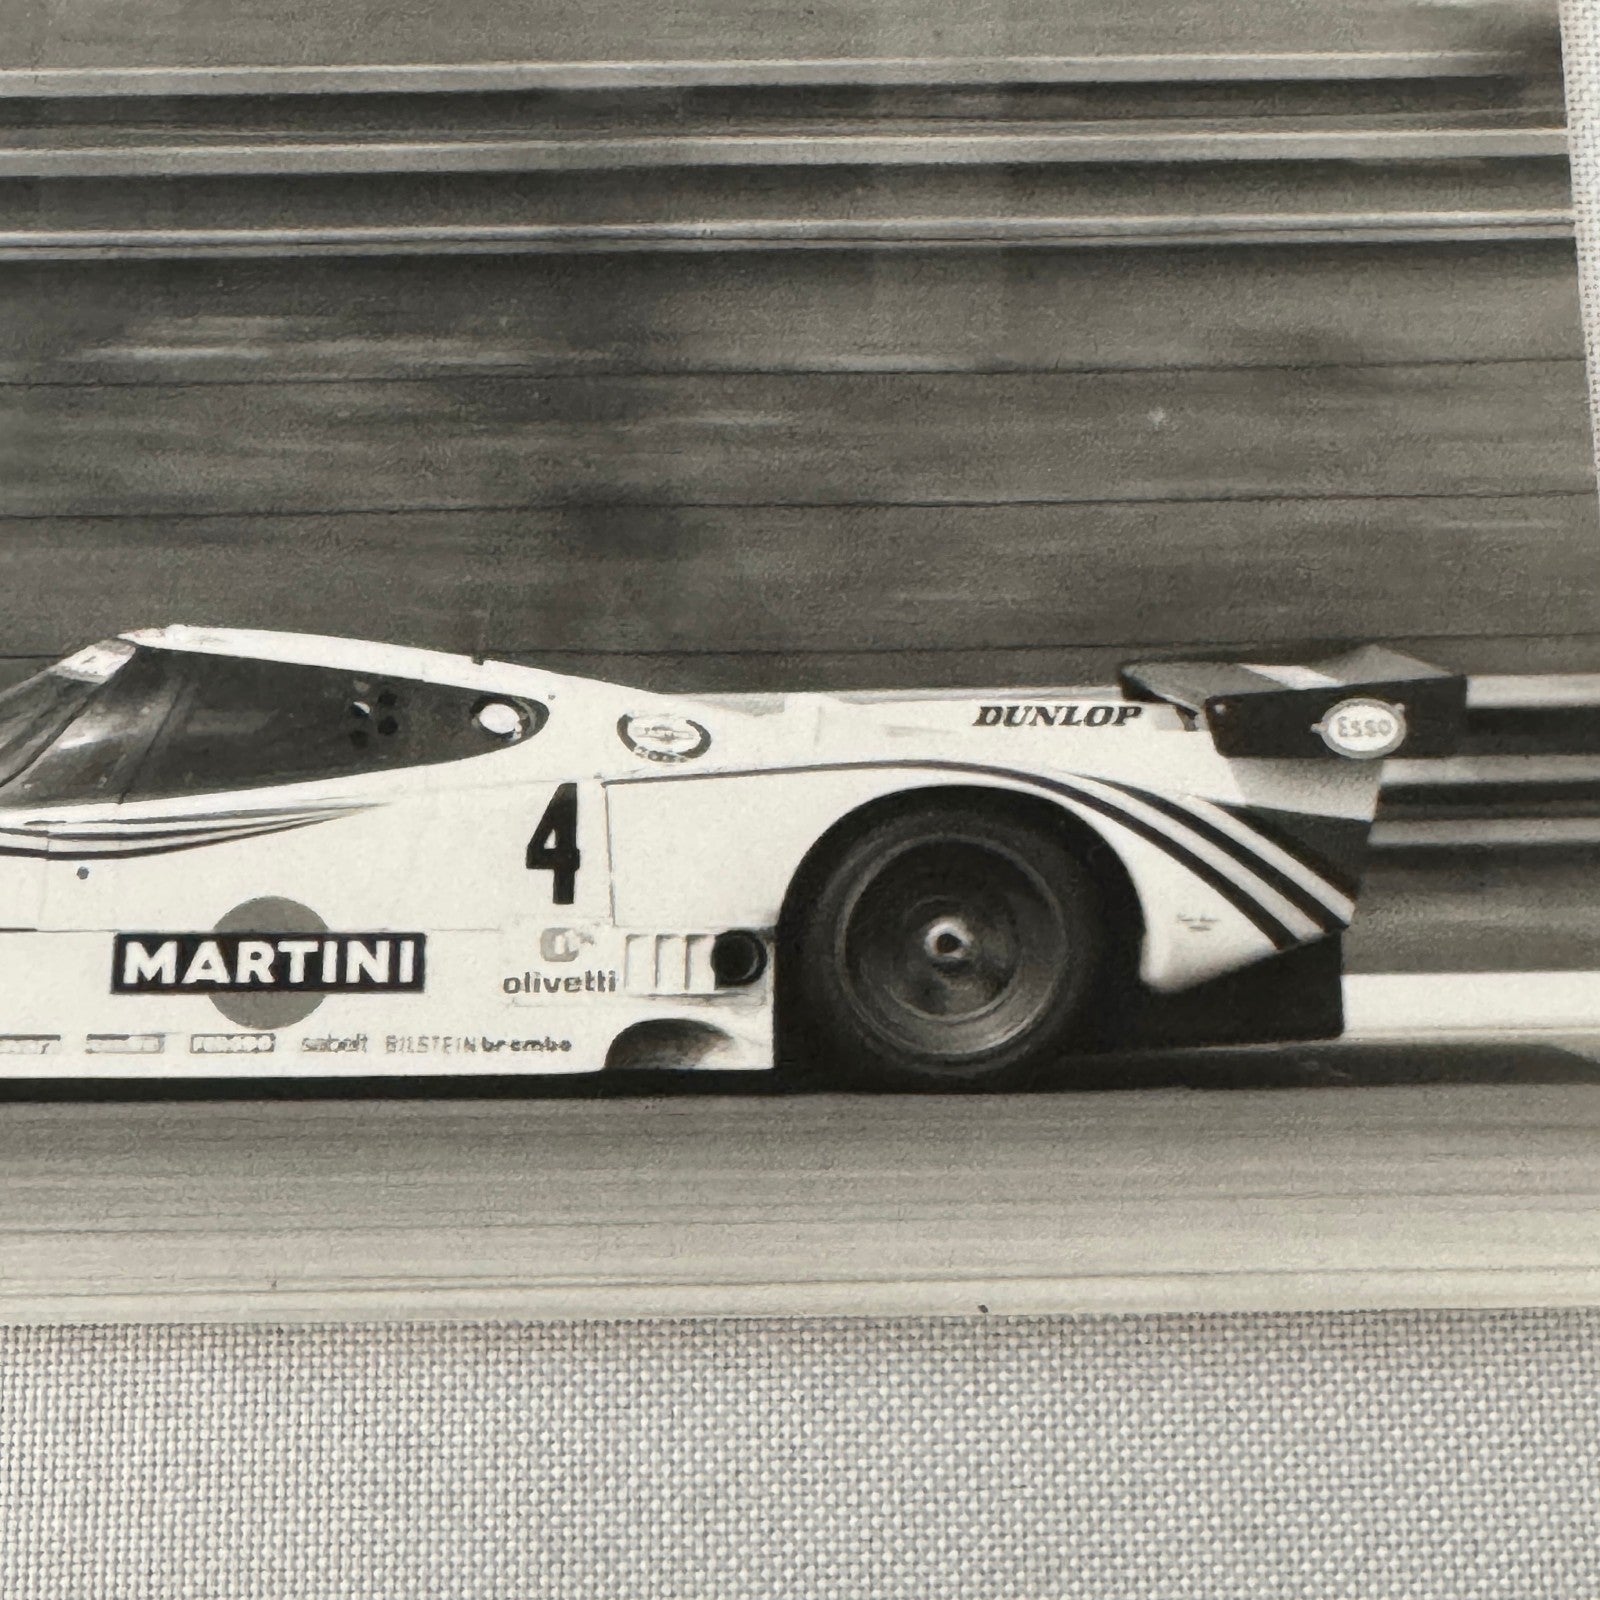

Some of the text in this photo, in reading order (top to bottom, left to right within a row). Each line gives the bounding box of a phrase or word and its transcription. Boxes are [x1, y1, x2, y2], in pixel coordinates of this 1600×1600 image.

[972, 706, 1142, 727] DUNLOP
[525, 782, 581, 905] 4
[123, 939, 414, 985] MARTINI
[503, 969, 616, 994] olivetti
[385, 1034, 476, 1054] BILSTEIN
